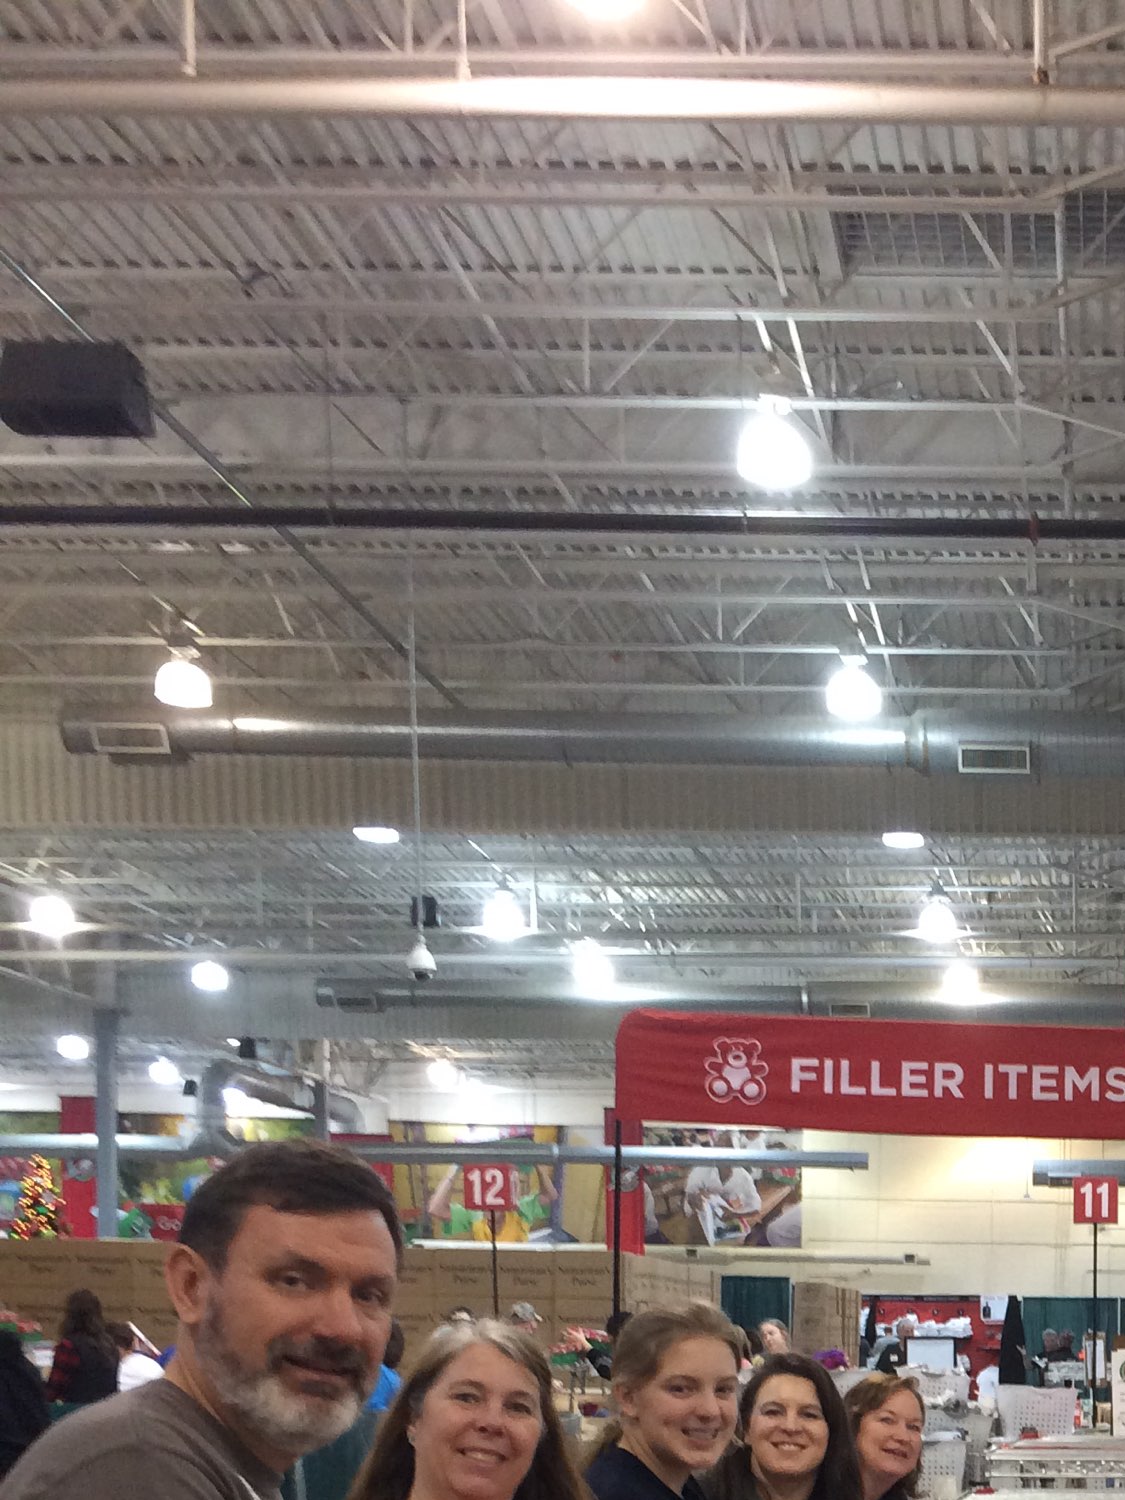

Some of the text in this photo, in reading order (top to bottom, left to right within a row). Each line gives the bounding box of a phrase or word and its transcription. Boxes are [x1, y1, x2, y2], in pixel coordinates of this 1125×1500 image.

[790, 1057, 965, 1099] FILLER
[467, 1167, 505, 1206] 12
[1080, 1182, 1109, 1219] 11
